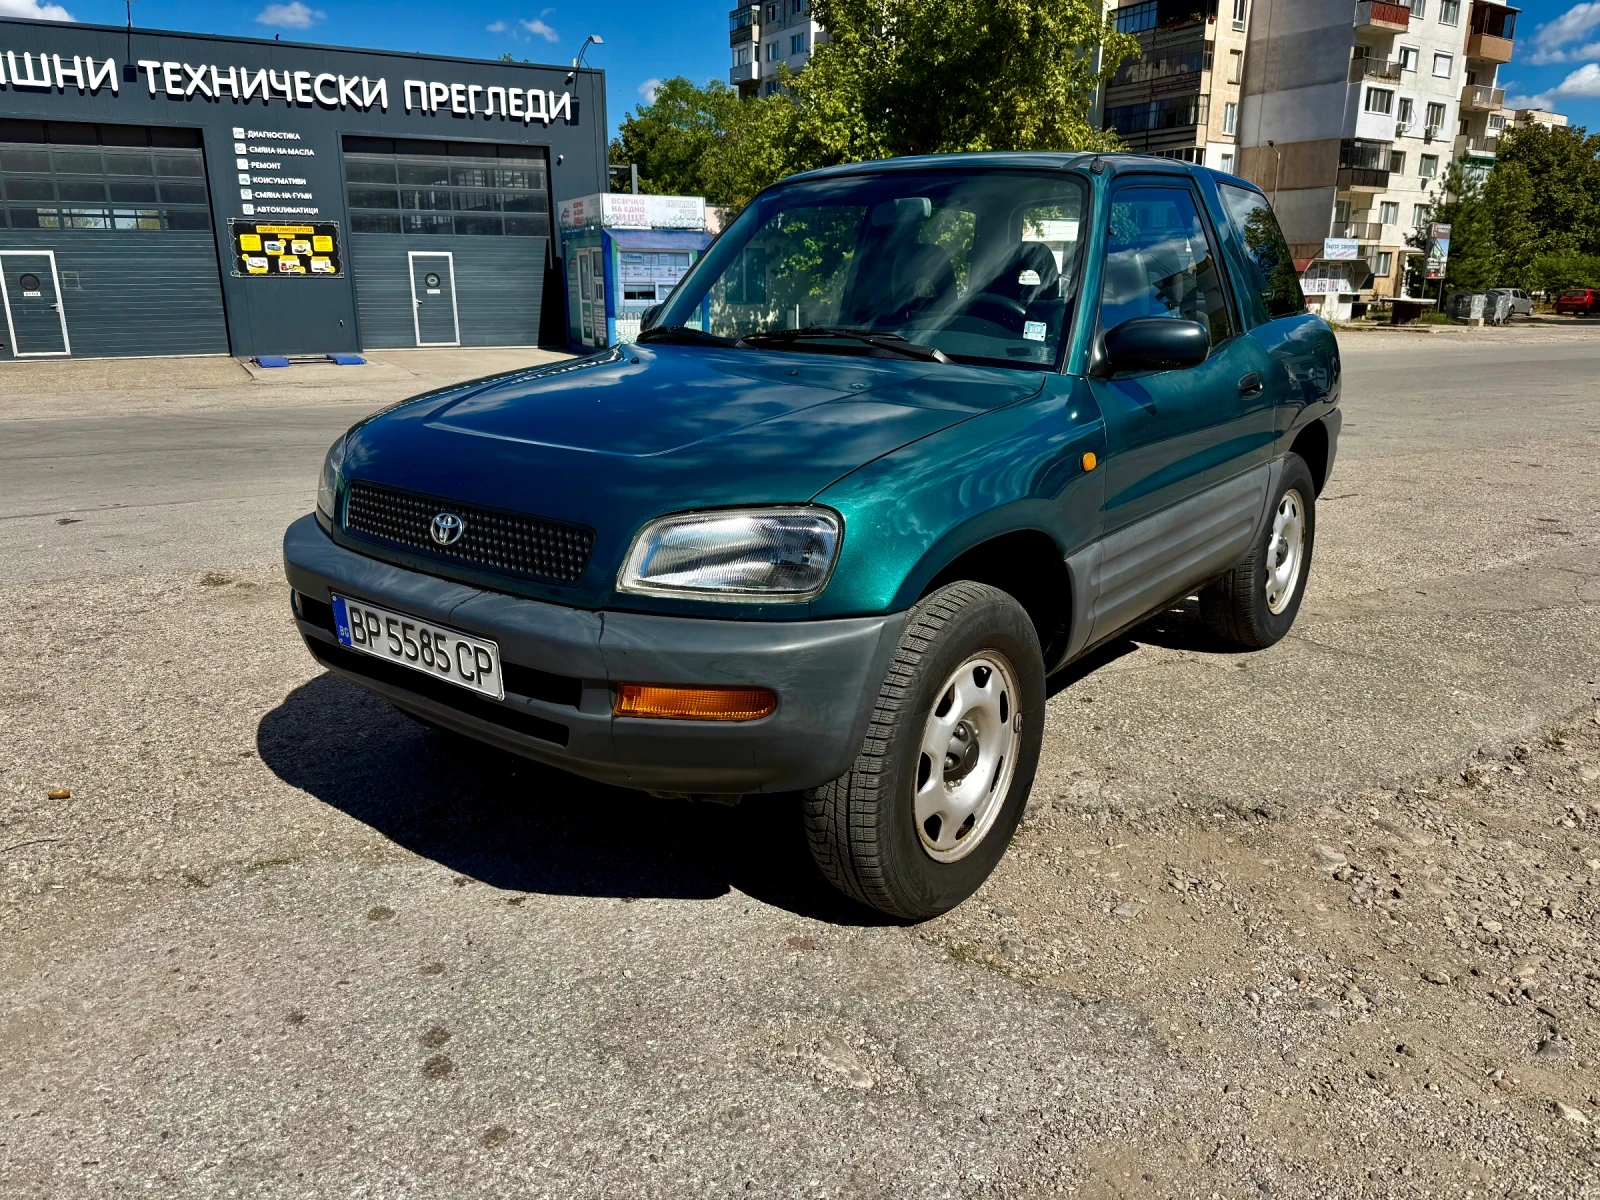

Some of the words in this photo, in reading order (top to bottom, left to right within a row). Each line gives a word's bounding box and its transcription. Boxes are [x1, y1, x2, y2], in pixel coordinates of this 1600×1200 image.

[0, 50, 118, 92] ШНИ
[137, 59, 388, 109] ТЕХНИЧЕСКИ
[404, 79, 572, 124] ПРЕГЛЕДИ
[247, 130, 301, 140] ДИАГНОСТИКА
[249, 146, 276, 154] СМЯНА
[276, 147, 287, 155] НА
[287, 148, 315, 156] МАСЛА
[250, 162, 281, 170] РЕМОНТ
[252, 176, 307, 186] КОНСУМАТИВИ
[254, 191, 281, 199] СМЯНА
[282, 192, 292, 200] НА
[293, 192, 313, 200] ГУМИ
[611, 197, 645, 205] ВСИЧКО
[256, 206, 319, 215] АВТОКЛИМАТИЦИ
[619, 311, 641, 324] ЗАС
[339, 626, 350, 638] BG
[349, 606, 381, 648] BP
[385, 617, 451, 673] 5585
[455, 641, 493, 685] CP
